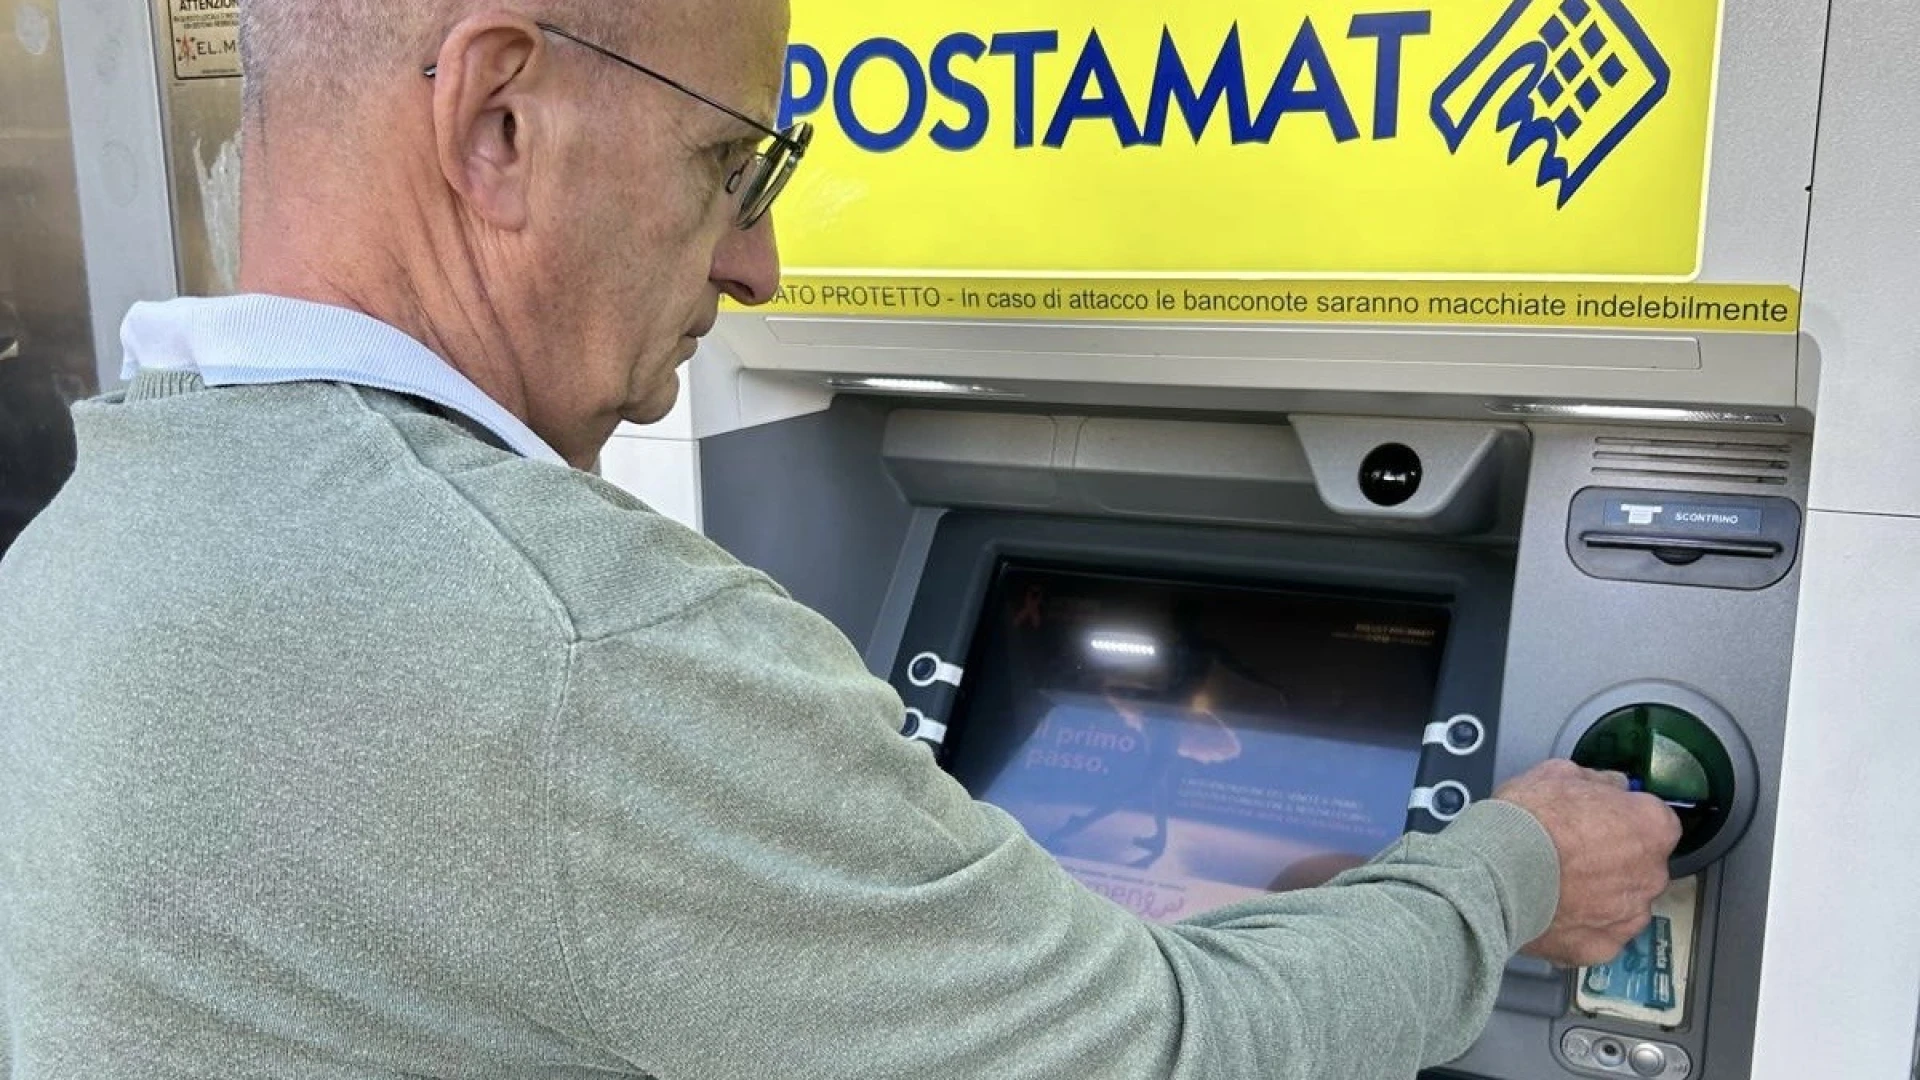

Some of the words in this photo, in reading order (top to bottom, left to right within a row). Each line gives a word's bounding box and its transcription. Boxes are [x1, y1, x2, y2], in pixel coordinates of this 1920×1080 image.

[777, 10, 1431, 153] POSTAMAT
[771, 284, 815, 305] ATO
[821, 286, 941, 307] PROTETTO
[961, 288, 980, 308] In
[986, 291, 1036, 310] caso
[1043, 288, 1062, 310] di
[1069, 289, 1148, 311] attacco
[1156, 289, 1175, 310] le
[1182, 290, 1308, 312] banconote
[1316, 295, 1419, 314] saranno
[1428, 292, 1566, 316] macchiate
[1576, 293, 1788, 322] indelebilmente
[1675, 511, 1739, 524] SCONTRINO
[1056, 723, 1136, 753] primo
